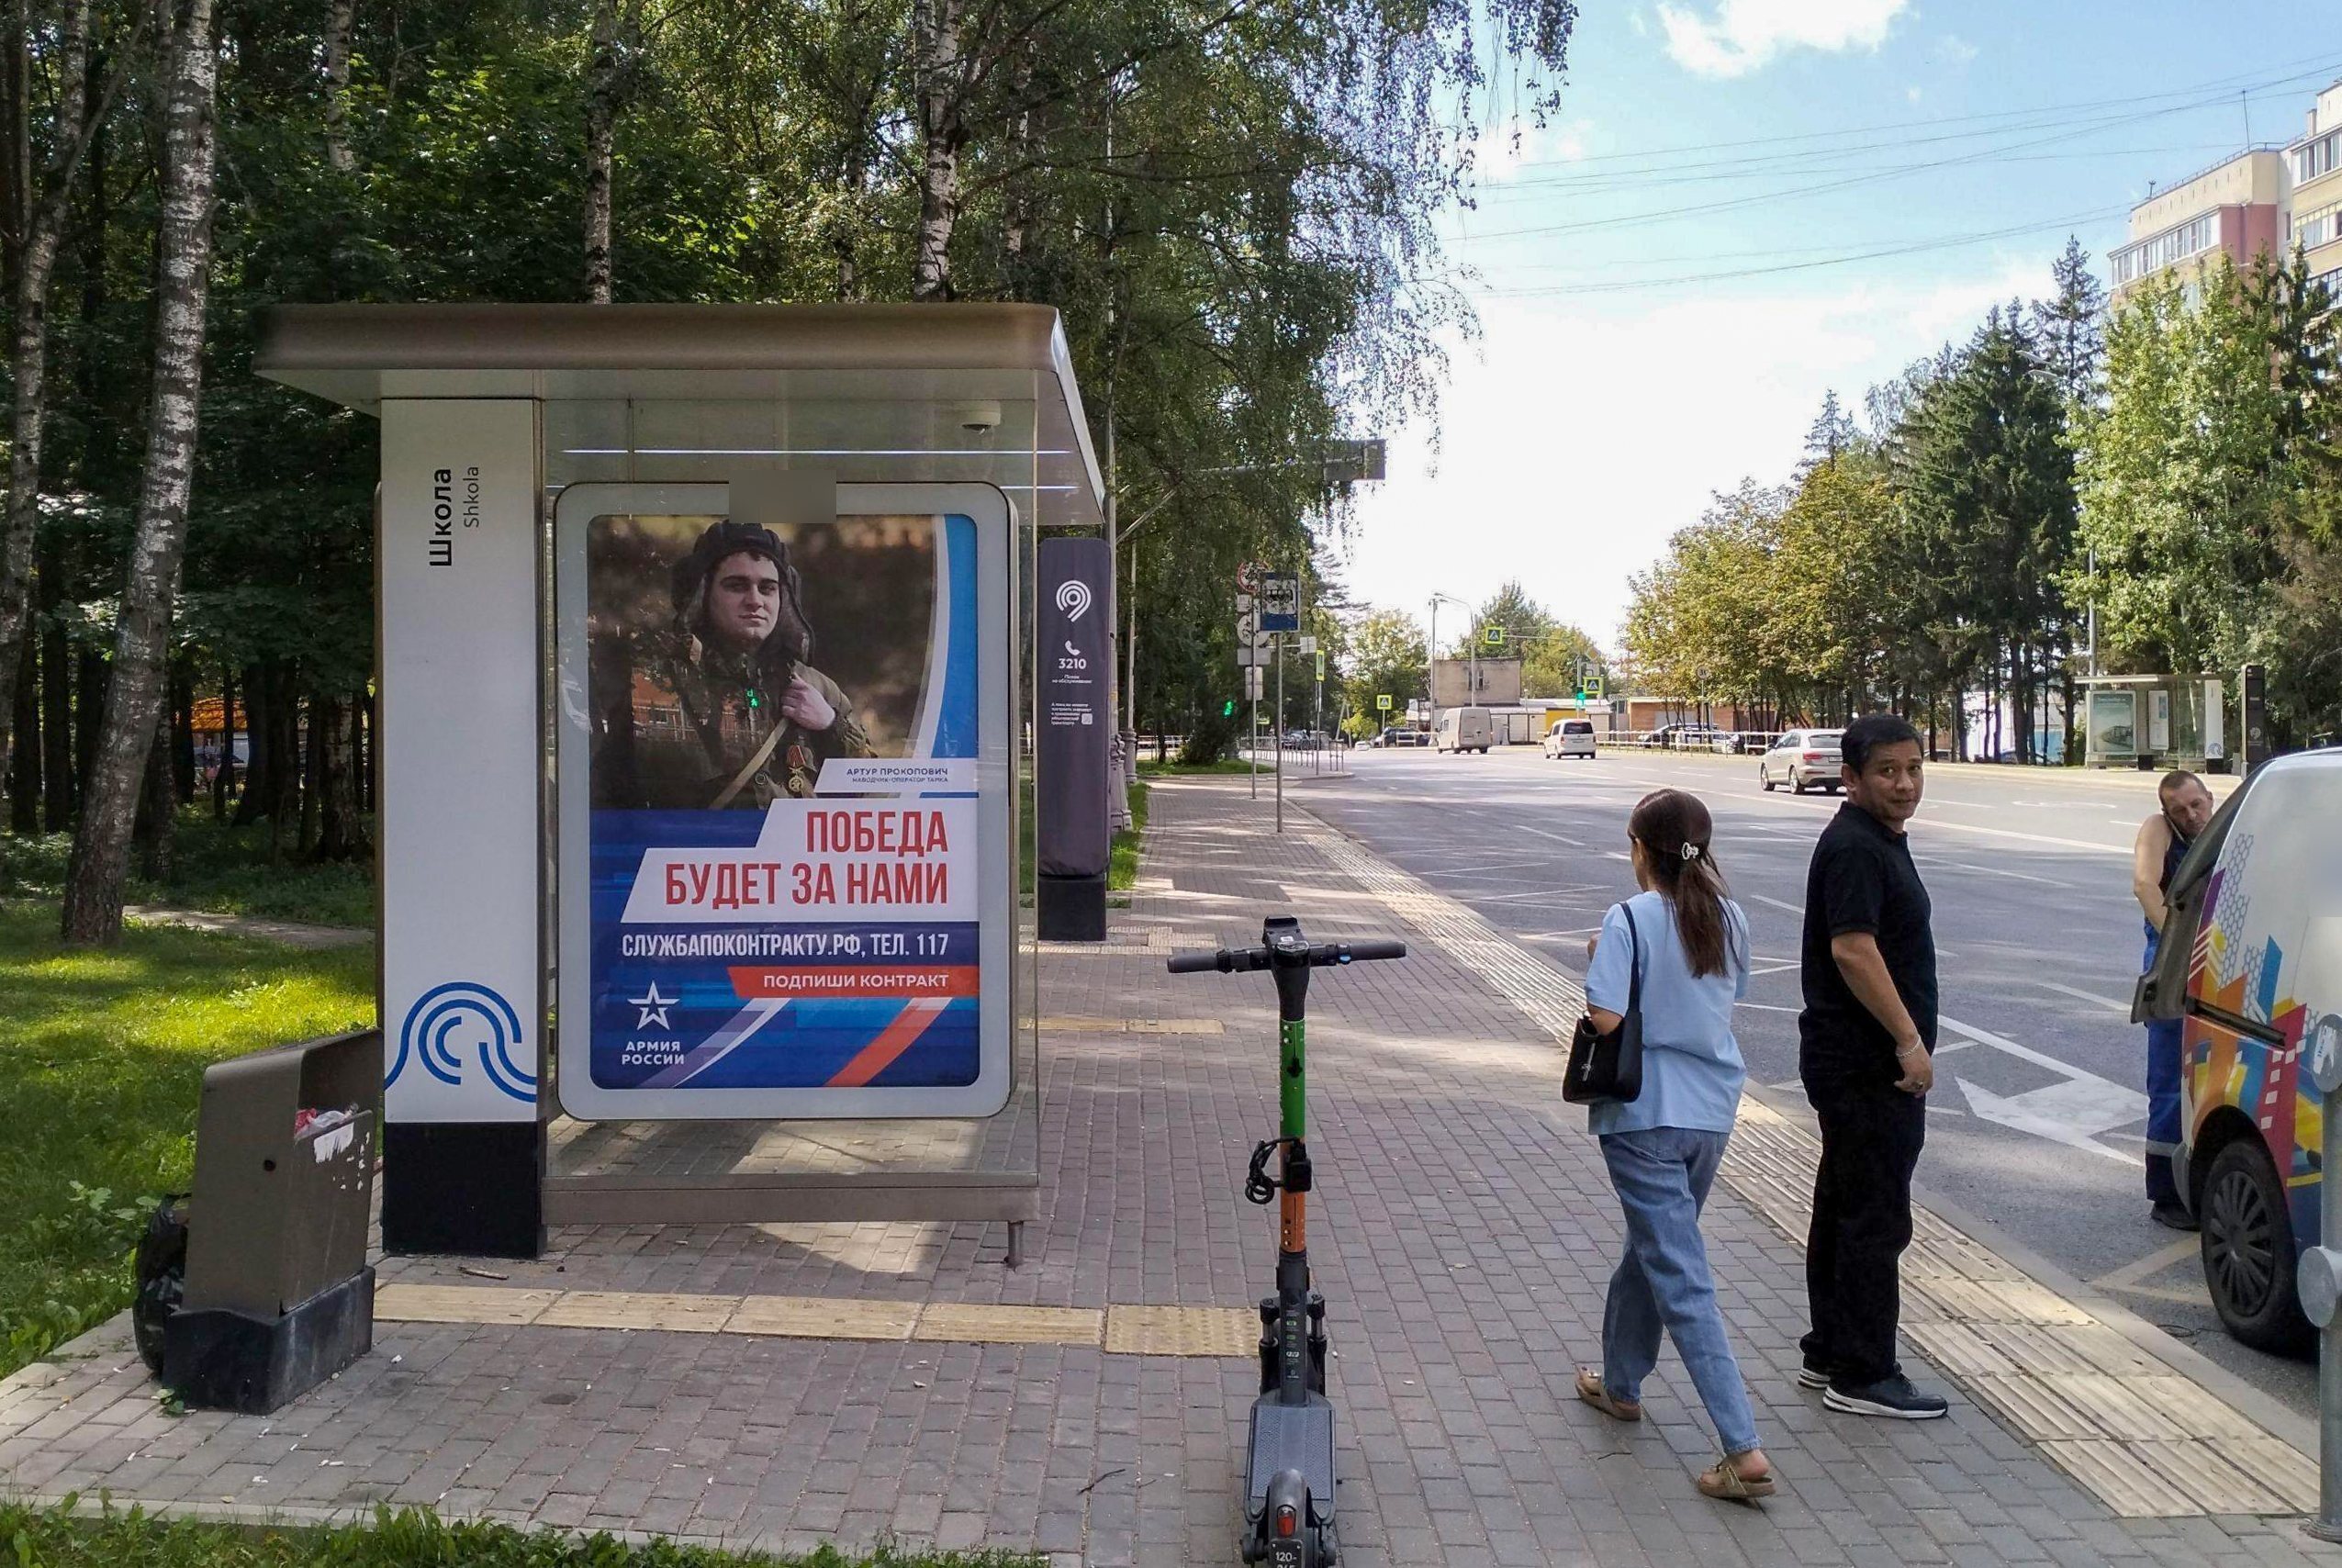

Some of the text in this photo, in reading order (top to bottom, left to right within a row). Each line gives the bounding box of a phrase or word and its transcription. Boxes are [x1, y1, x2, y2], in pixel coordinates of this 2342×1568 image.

[463, 466, 479, 528] Shkola
[429, 469, 452, 566] Школа
[1059, 658, 1087, 670] 3210
[846, 767, 948, 776] АРТУР ПРОКОПОВИЧ
[806, 811, 948, 857] ПОБЕДА
[666, 862, 947, 910] БУДЕТ ЗА НАМИ
[622, 933, 949, 958] СЛУЖБАПОКОНТРАКТУ.РФ, ТЕЛ. 117
[763, 974, 949, 990] ПОДПИШИ КОНТРАКТ
[626, 1041, 680, 1052] АРМИЯ
[622, 1054, 685, 1066] РОССИИ
